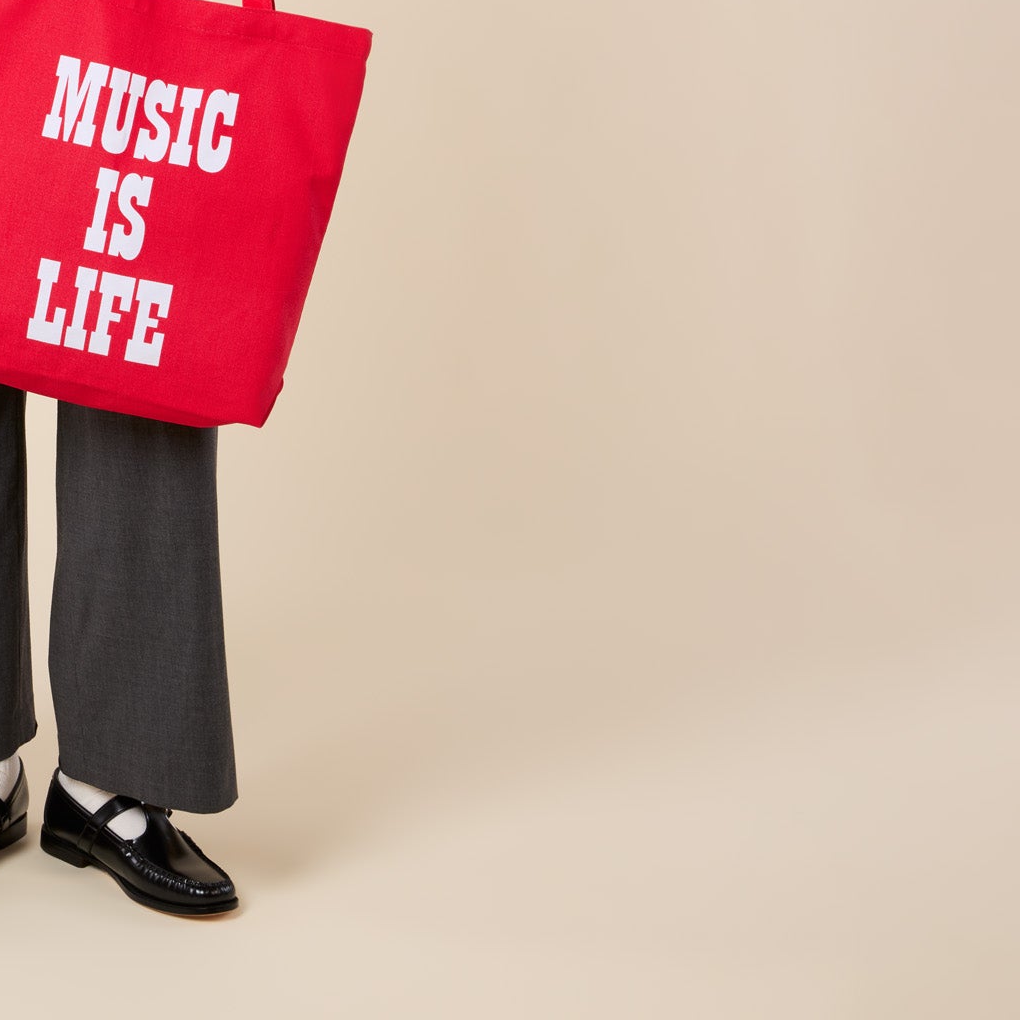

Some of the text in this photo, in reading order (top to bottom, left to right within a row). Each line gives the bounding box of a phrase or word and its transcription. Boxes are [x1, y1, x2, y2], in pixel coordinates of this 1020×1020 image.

[42, 55, 239, 173] MUSIC
[83, 167, 153, 260] IS
[27, 258, 173, 366] LIFE
